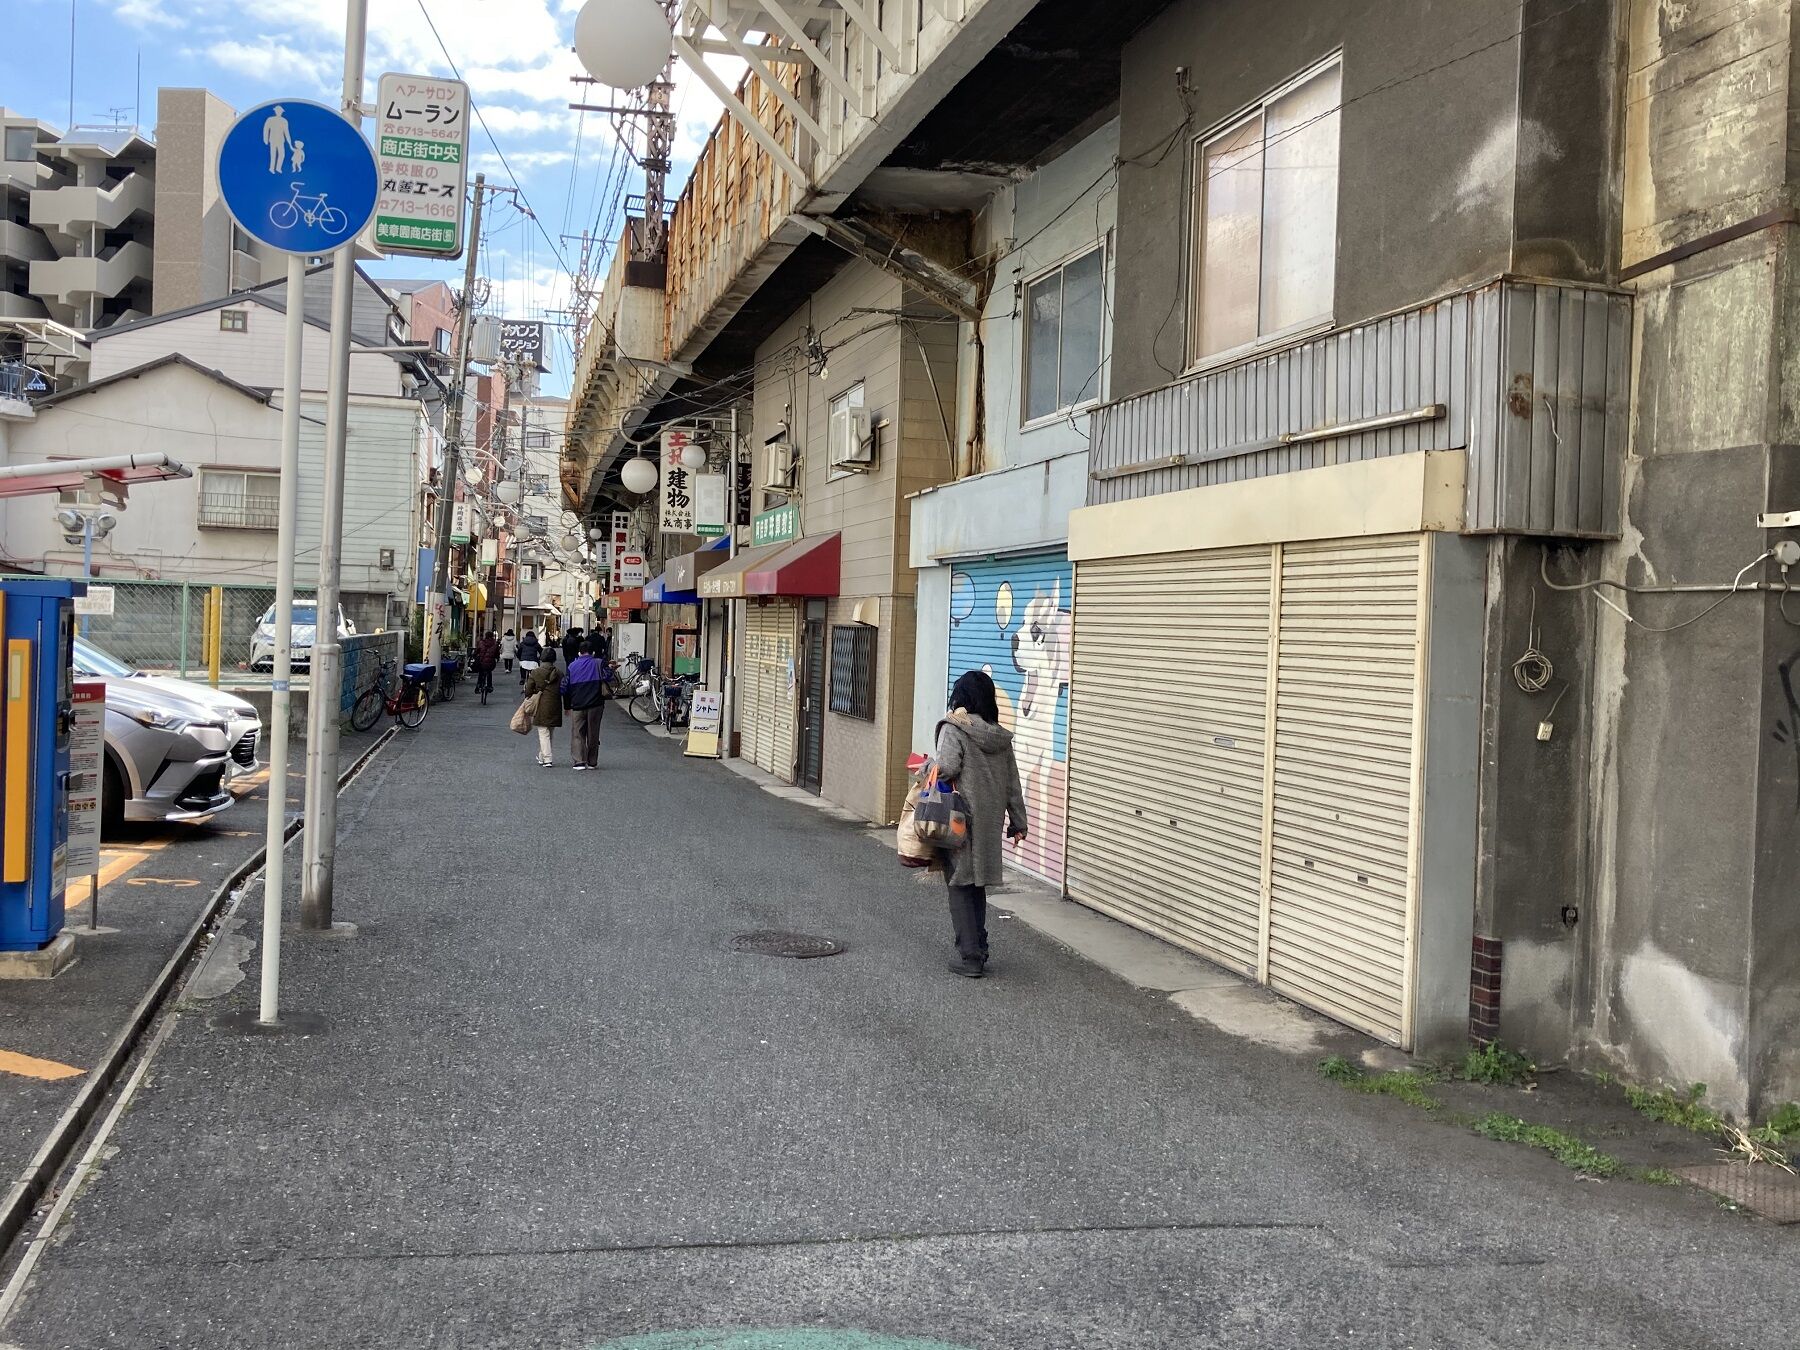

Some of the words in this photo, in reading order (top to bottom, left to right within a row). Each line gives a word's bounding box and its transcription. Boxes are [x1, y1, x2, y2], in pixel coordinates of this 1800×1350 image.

[396, 85, 456, 101] ヘアーサロン
[386, 101, 460, 125] ムーラン
[397, 126, 460, 139] 6713-5647
[382, 139, 459, 162] 商店街中央
[381, 161, 439, 180] 学校服の
[383, 178, 455, 198] 丸善エース
[389, 199, 455, 218] 713-1616
[665, 509, 692, 518] 株式会社
[696, 704, 718, 714] シャトー
